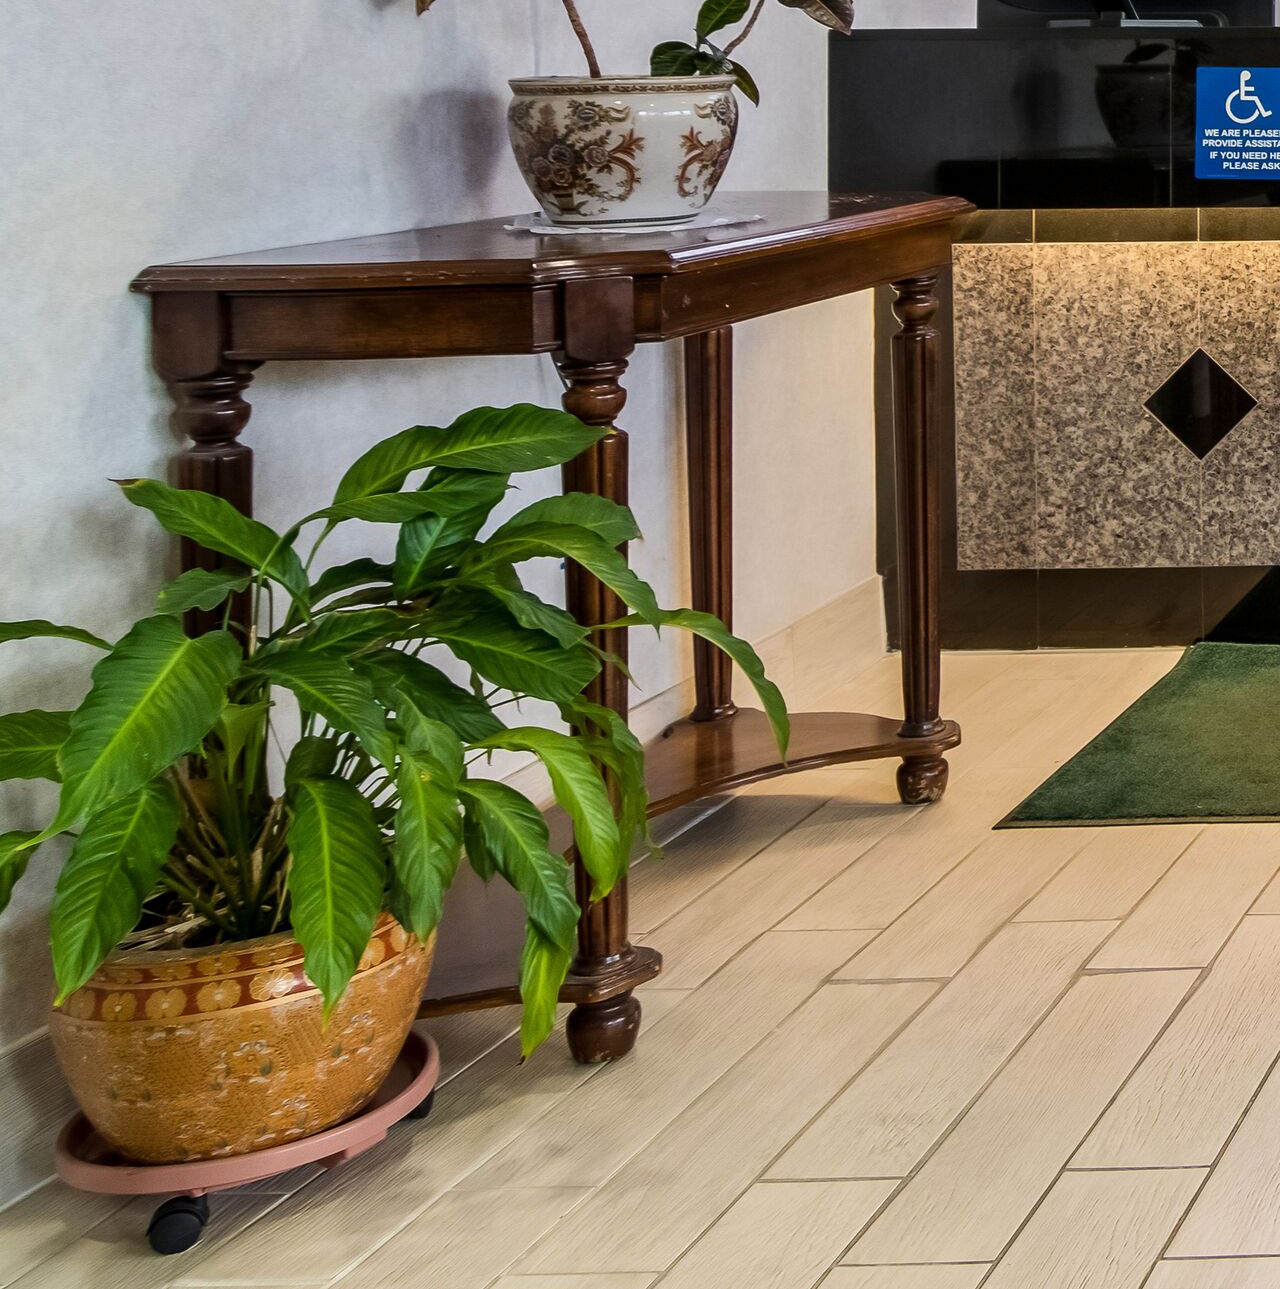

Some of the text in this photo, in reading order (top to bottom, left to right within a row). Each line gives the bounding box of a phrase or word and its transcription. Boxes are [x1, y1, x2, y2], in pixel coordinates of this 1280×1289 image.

[1204, 129, 1219, 137] WE
[1221, 129, 1240, 137] ARE
[1202, 139, 1243, 147] PROVIDE
[1209, 151, 1218, 159] IF
[1220, 151, 1240, 159] YOU
[1242, 152, 1268, 160] NEED
[1222, 162, 1280, 170] PLEASE ASK
